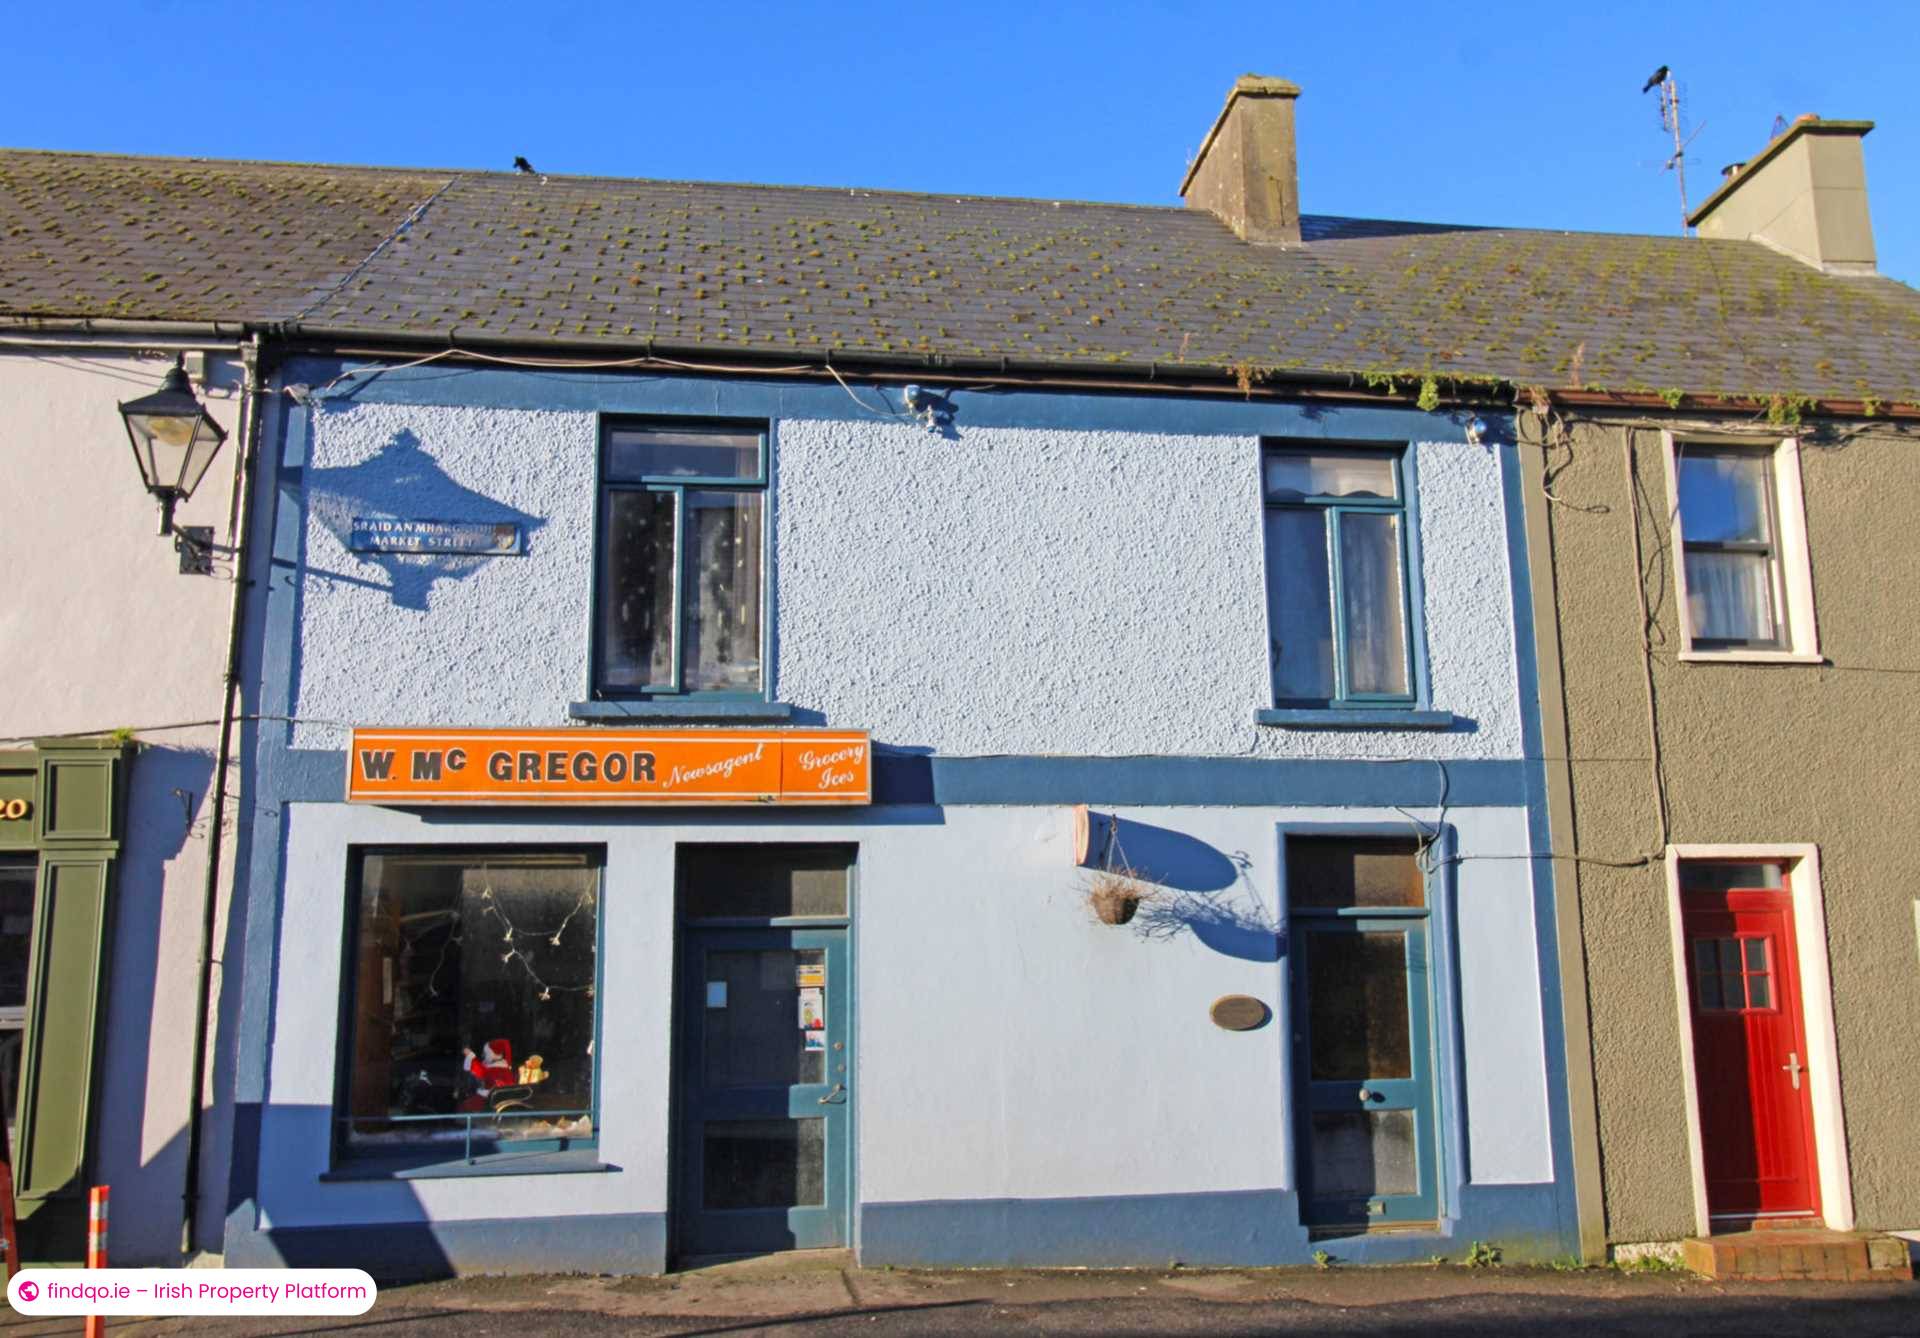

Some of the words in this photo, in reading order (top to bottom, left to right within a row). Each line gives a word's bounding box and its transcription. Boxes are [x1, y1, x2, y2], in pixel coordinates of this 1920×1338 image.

[395, 521, 413, 533] AN
[370, 535, 422, 547] MARKET
[487, 750, 657, 783] GREGOR
[662, 742, 765, 788] Newsagent
[799, 744, 865, 770] Grocery
[818, 767, 855, 789] Ices
